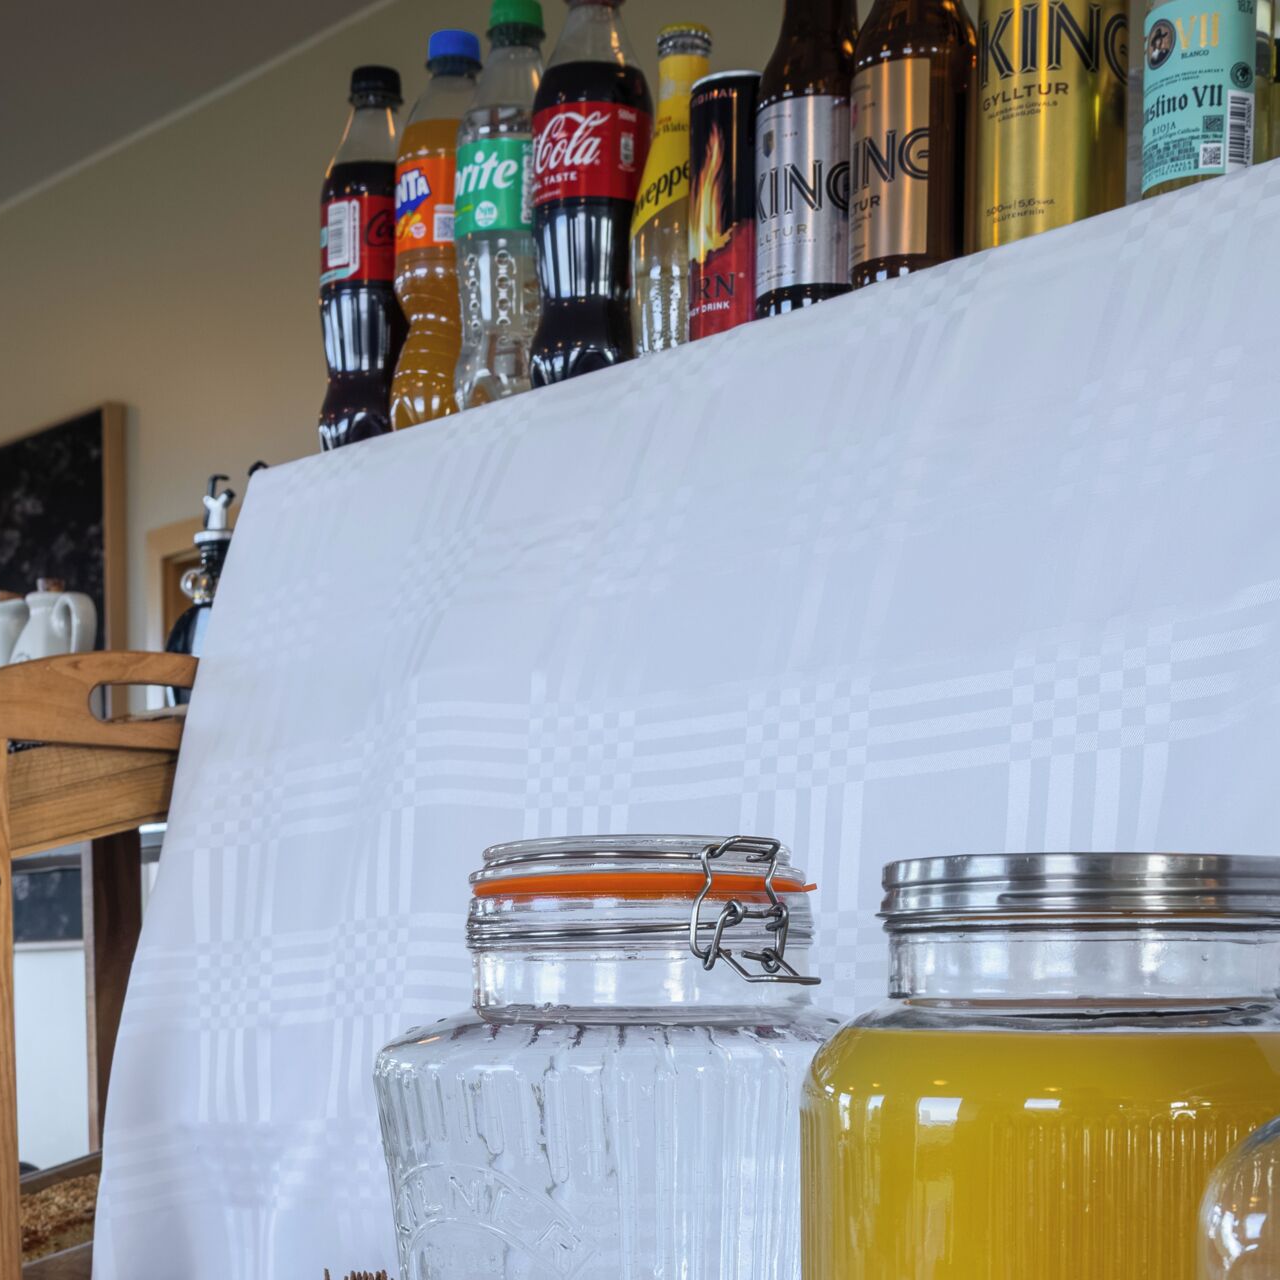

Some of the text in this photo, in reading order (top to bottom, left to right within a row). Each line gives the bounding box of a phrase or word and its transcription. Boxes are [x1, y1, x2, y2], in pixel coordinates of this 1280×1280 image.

[1175, 12, 1221, 49] VII
[1181, 50, 1210, 60] BLANCO
[983, 82, 1069, 112] GYLLTUR
[1192, 84, 1223, 109] VII
[1152, 121, 1177, 136] RIOJA
[394, 168, 431, 209] NTA
[544, 171, 578, 186] TASTE
[635, 159, 690, 218] weppe
[701, 300, 730, 313] DRINK
